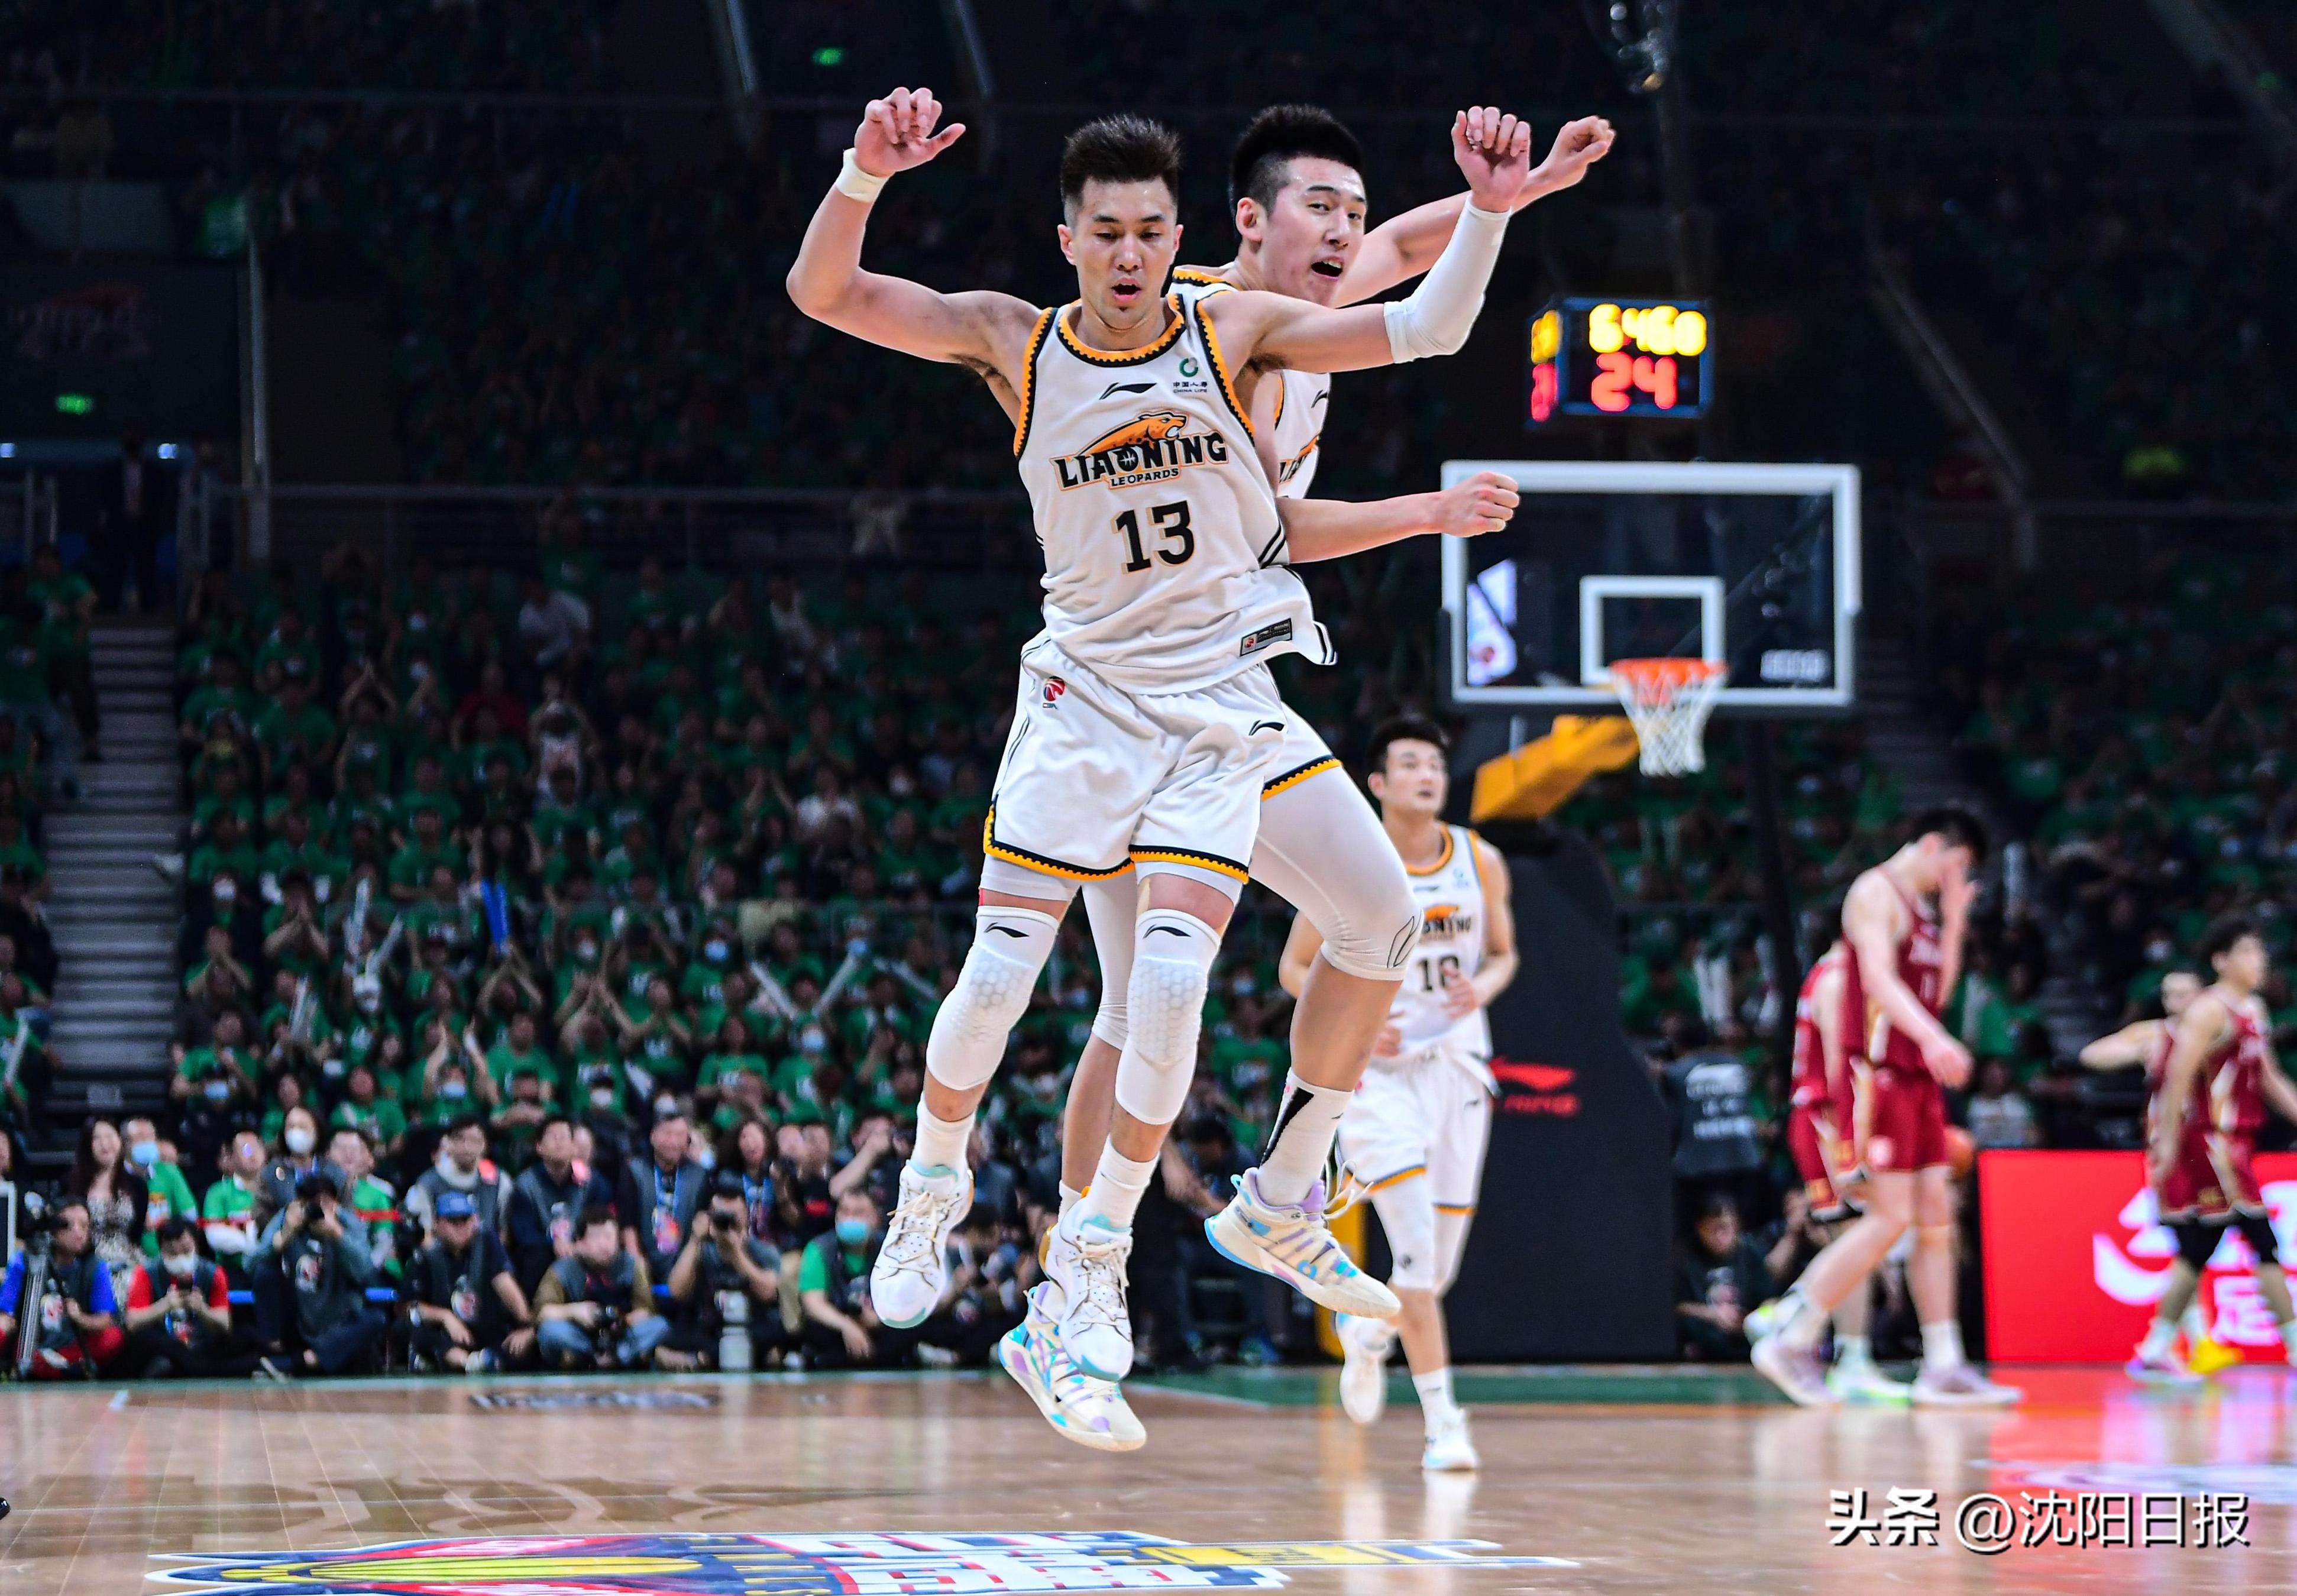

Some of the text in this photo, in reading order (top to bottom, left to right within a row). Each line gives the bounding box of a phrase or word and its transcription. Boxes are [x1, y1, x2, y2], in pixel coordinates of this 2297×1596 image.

[1591, 351, 1677, 412] 24
[1054, 432, 1228, 488] LIAONING
[1110, 468, 1180, 487] LEOPARDS
[1110, 500, 1195, 574] 13
